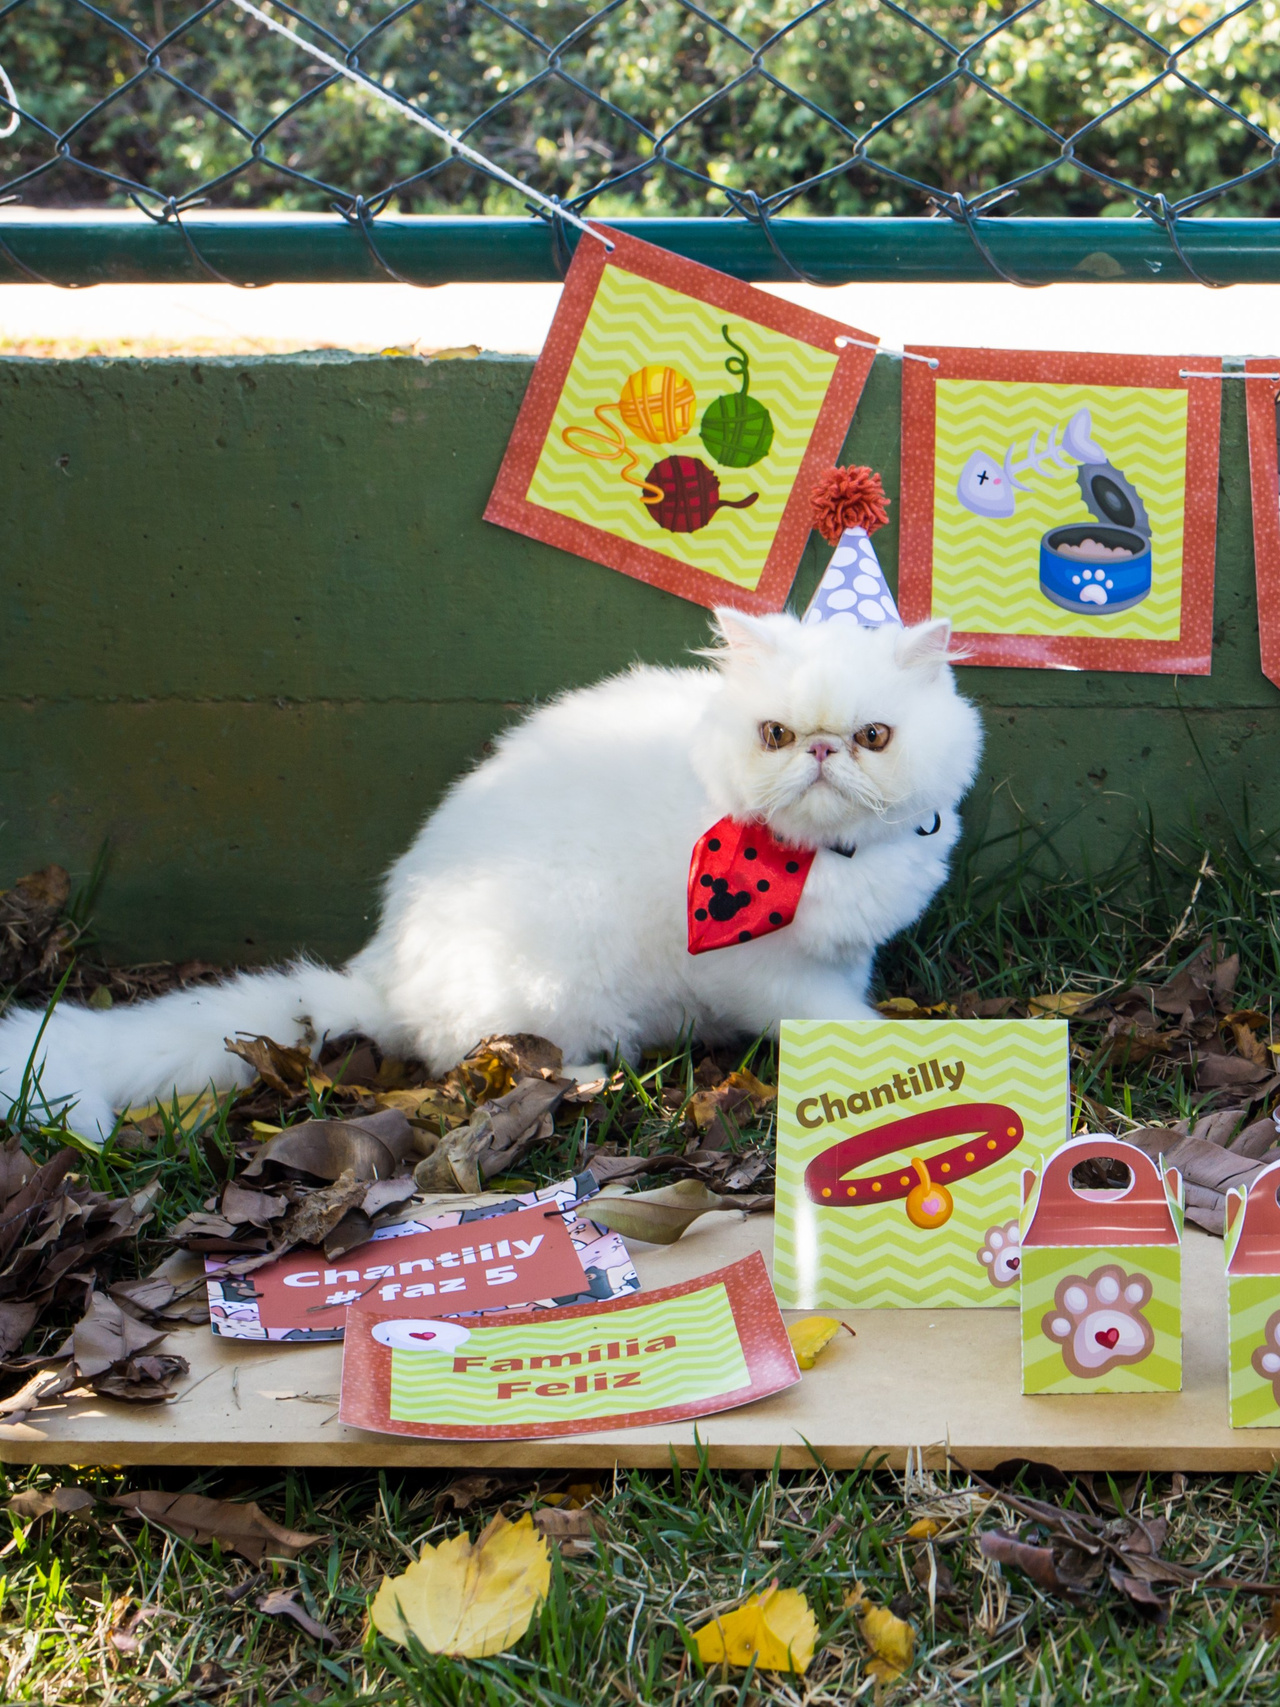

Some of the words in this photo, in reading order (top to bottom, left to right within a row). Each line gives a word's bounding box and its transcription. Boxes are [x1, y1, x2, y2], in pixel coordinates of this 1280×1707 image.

[795, 1058, 966, 1130] Chantilly
[283, 1234, 545, 1288] Chantilly
[378, 1277, 467, 1302] faz
[485, 1264, 518, 1286] 5
[497, 1371, 642, 1400] Feliz
